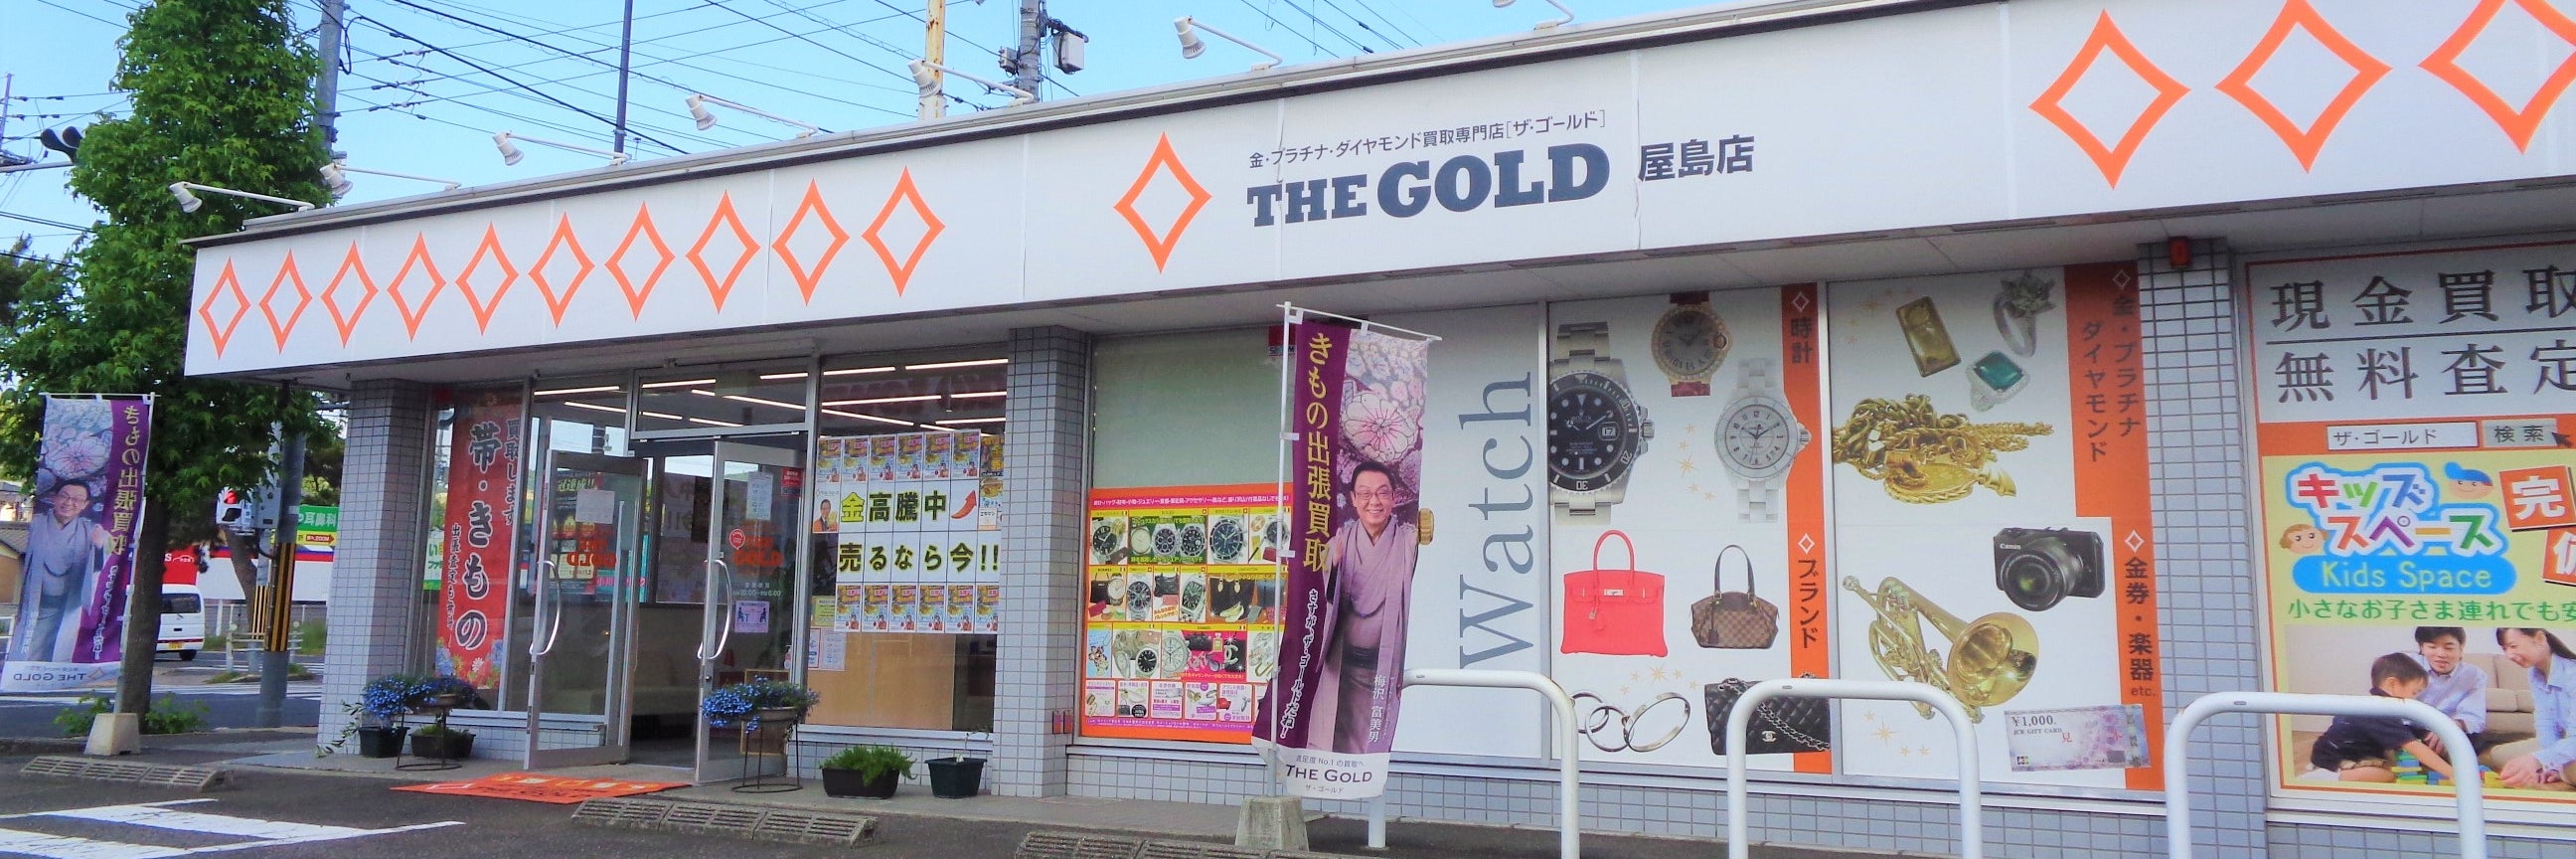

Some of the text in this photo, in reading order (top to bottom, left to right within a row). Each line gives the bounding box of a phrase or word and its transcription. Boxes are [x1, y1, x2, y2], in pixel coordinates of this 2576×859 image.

[1638, 134, 1754, 182] 屋島店
[1246, 143, 1610, 228] THE GOLD
[2270, 264, 2576, 332] 現金買取
[1790, 317, 1813, 363] 時計
[2082, 321, 2108, 461] ダイヤモンド
[2275, 339, 2576, 403] 無料査定
[1303, 333, 1332, 572] きもの出張買取
[2334, 425, 2544, 446] ザ・ゴールド 検索
[841, 490, 946, 524] 金高騰中
[2298, 473, 2426, 508] キッズ
[2511, 475, 2565, 520] 完
[455, 421, 502, 650] 帯・きもの
[1458, 372, 1533, 669] Watch
[2328, 515, 2494, 550] スペース
[839, 543, 999, 573] 売るなら今!!
[2322, 561, 2492, 592] Kids Space
[1798, 559, 1820, 648] ブランド
[2125, 557, 2154, 681] 金券・楽器
[2131, 686, 2156, 697] etc.
[1286, 765, 1372, 783] THE GOLD
